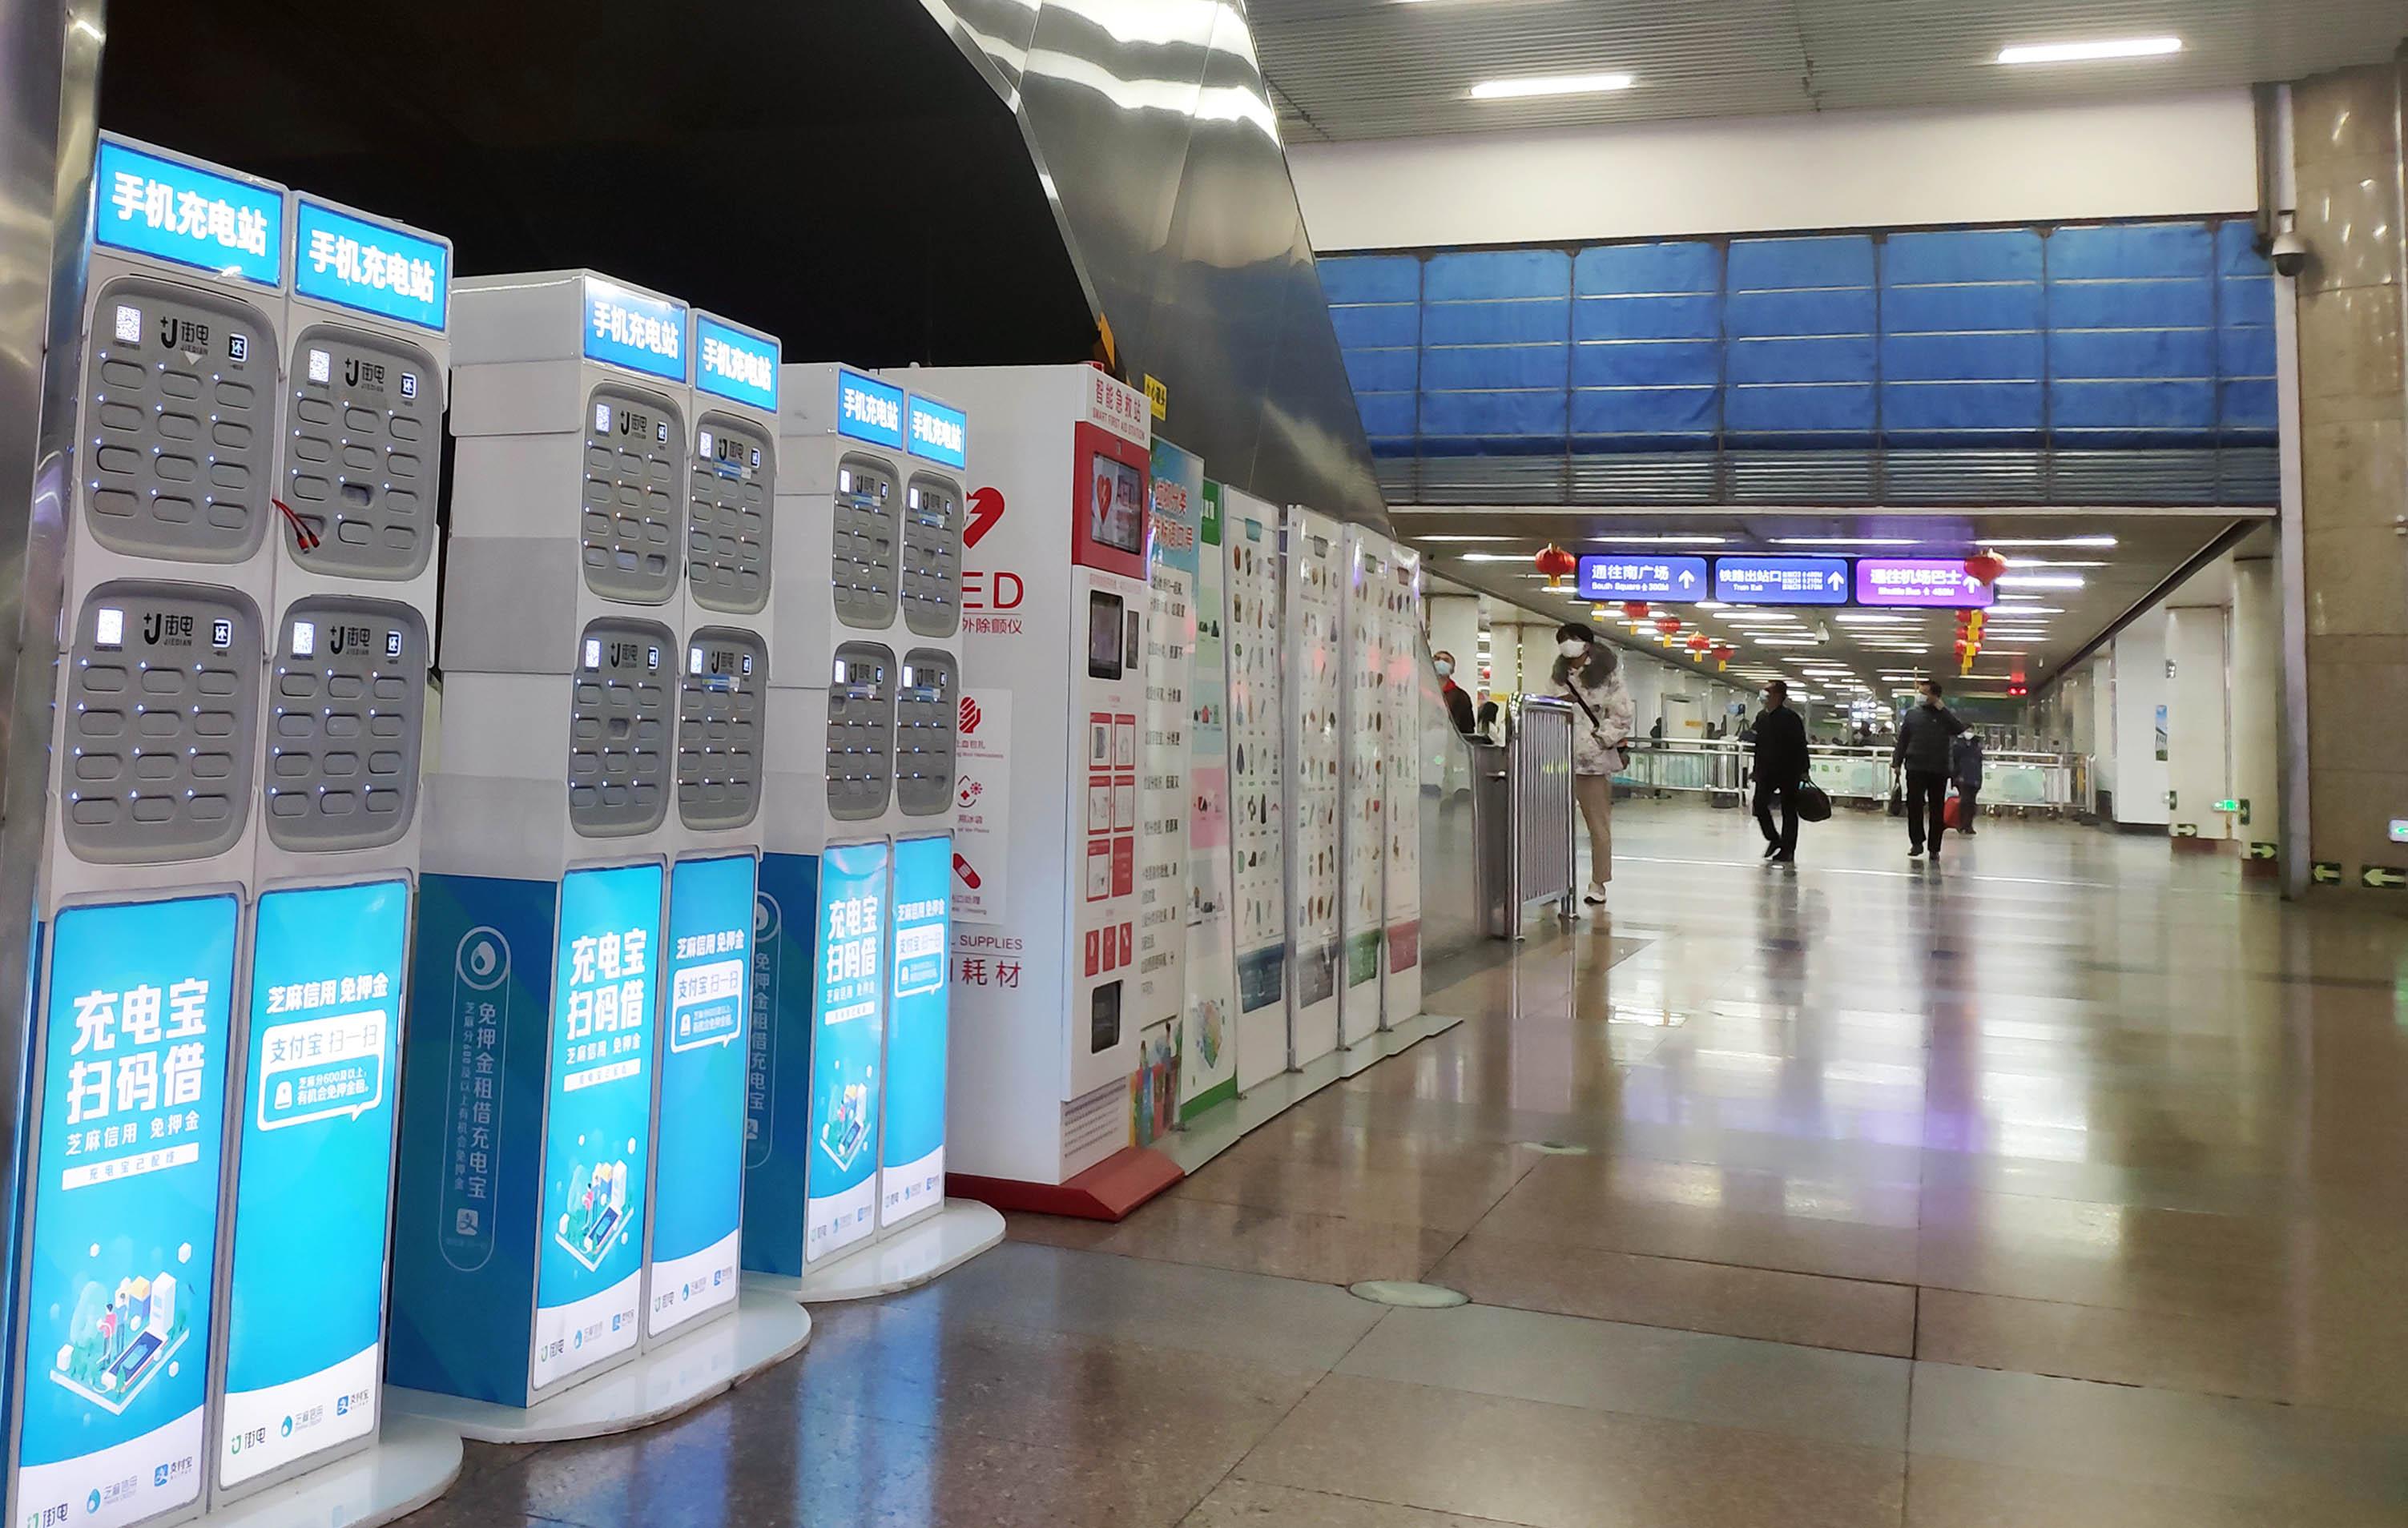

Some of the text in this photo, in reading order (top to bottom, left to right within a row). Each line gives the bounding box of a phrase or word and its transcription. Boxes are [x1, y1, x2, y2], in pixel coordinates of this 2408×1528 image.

[111, 171, 268, 256] 手机充电站
[308, 230, 435, 304] 手机充电站
[181, 321, 208, 345] 街电
[593, 300, 679, 360] 手机充电站
[703, 337, 771, 392] 手机充电站
[843, 388, 898, 432] 手机充电站
[912, 410, 961, 452] 手机充电站
[1592, 565, 1669, 581] 通往南广场
[1592, 582, 1613, 590] South
[1615, 582, 1641, 591] Square
[1719, 569, 1782, 582] 铁路出站口
[1870, 569, 1963, 585] 通往机场巴士
[165, 615, 193, 636] 街电
[348, 627, 370, 646] 街电
[827, 895, 878, 941] 充电宝
[569, 927, 647, 987] 充电宝
[675, 929, 745, 959] 芝麻信用 免押金
[827, 937, 876, 984] 扫码借
[960, 935, 1023, 951] SUPPLIES
[266, 972, 389, 1015] 芝麻信用 免押金
[679, 976, 707, 999] 支付宝
[950, 957, 1021, 988] 耗材
[70, 977, 210, 1056] 充电宝
[566, 979, 644, 1040] 扫码借
[270, 1023, 378, 1064] 支付宝 扫一扫
[566, 1032, 641, 1065] 芝麻信用 免押金
[66, 1043, 205, 1125] 扫码借
[468, 1003, 497, 1199] 免押金租借充电宝
[65, 1110, 201, 1156] 芝麻信用 免押金
[244, 1427, 266, 1450] 街电
